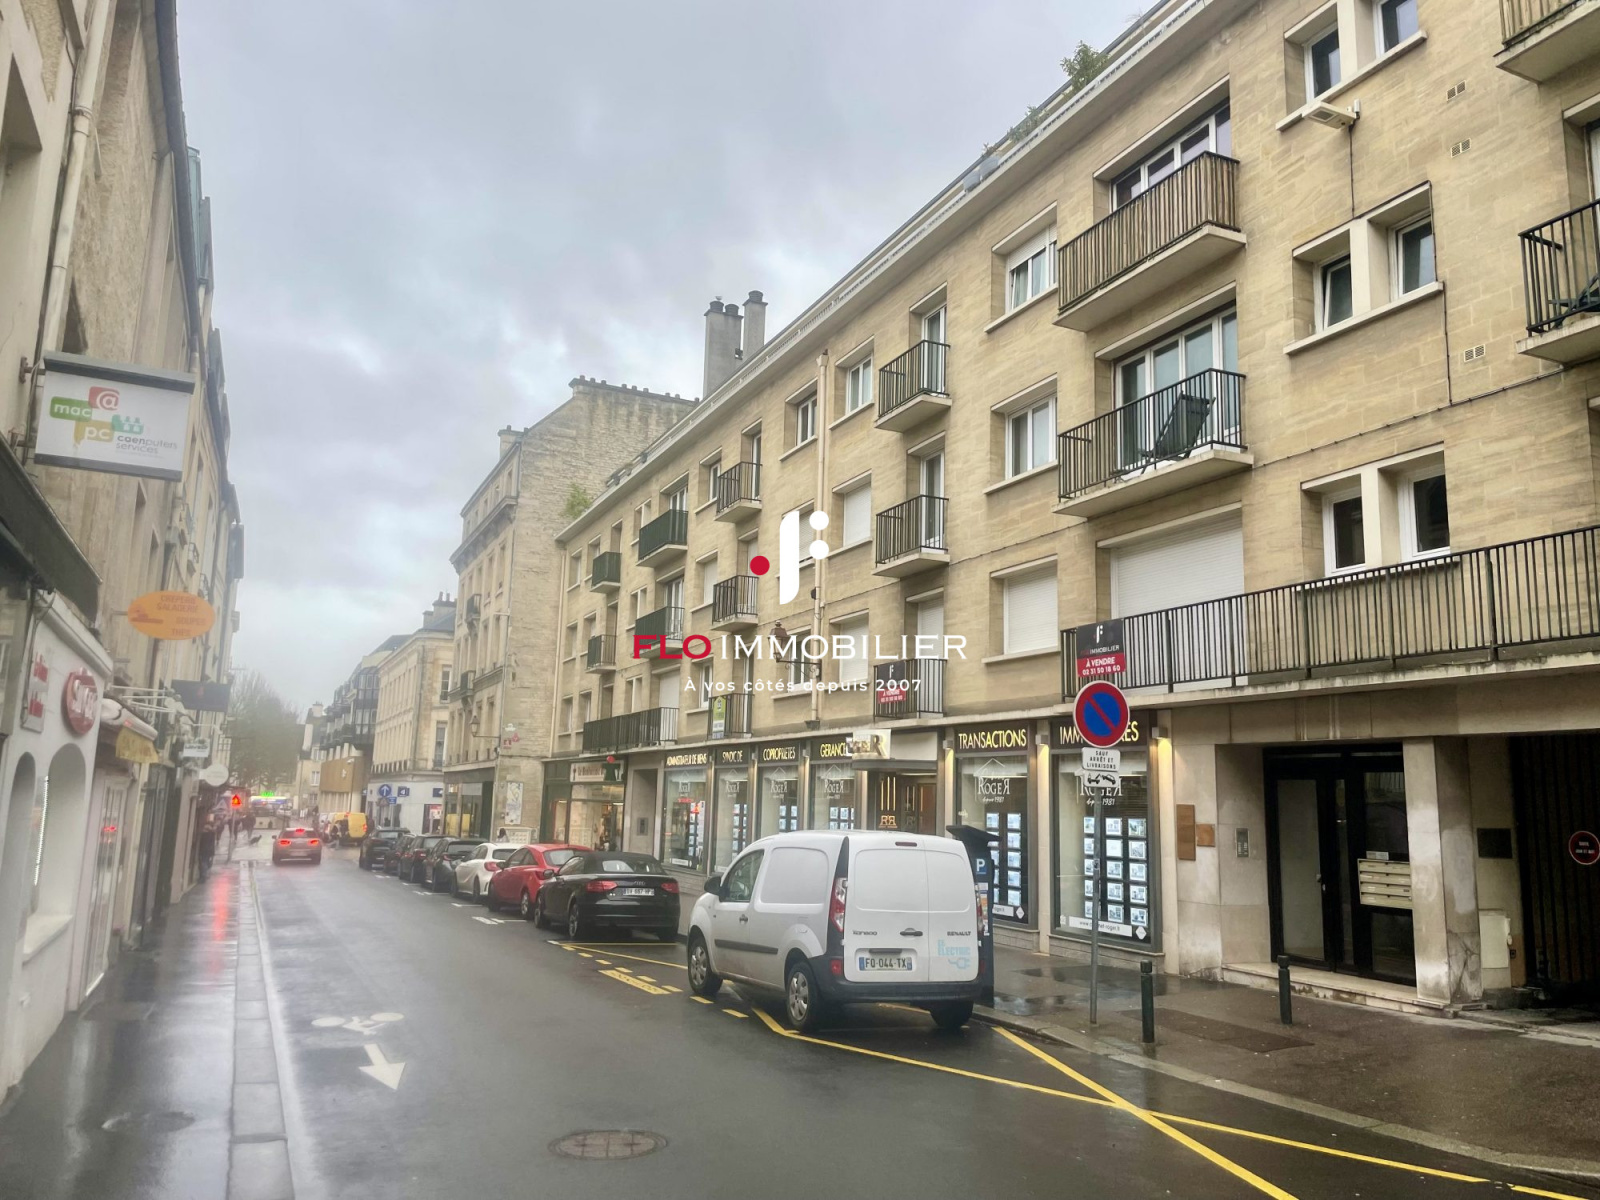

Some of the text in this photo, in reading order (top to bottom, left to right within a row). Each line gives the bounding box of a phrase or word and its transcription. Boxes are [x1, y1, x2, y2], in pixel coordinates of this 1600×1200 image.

[54, 403, 92, 418] mac
[84, 426, 111, 440] pc
[115, 442, 159, 455] services
[1091, 656, 1116, 666] VENDRE
[958, 728, 1027, 749] TRANSACTIONS
[1086, 762, 1116, 770] LIVRAISONS
[1102, 798, 1115, 806] 1981
[976, 858, 985, 872] P
